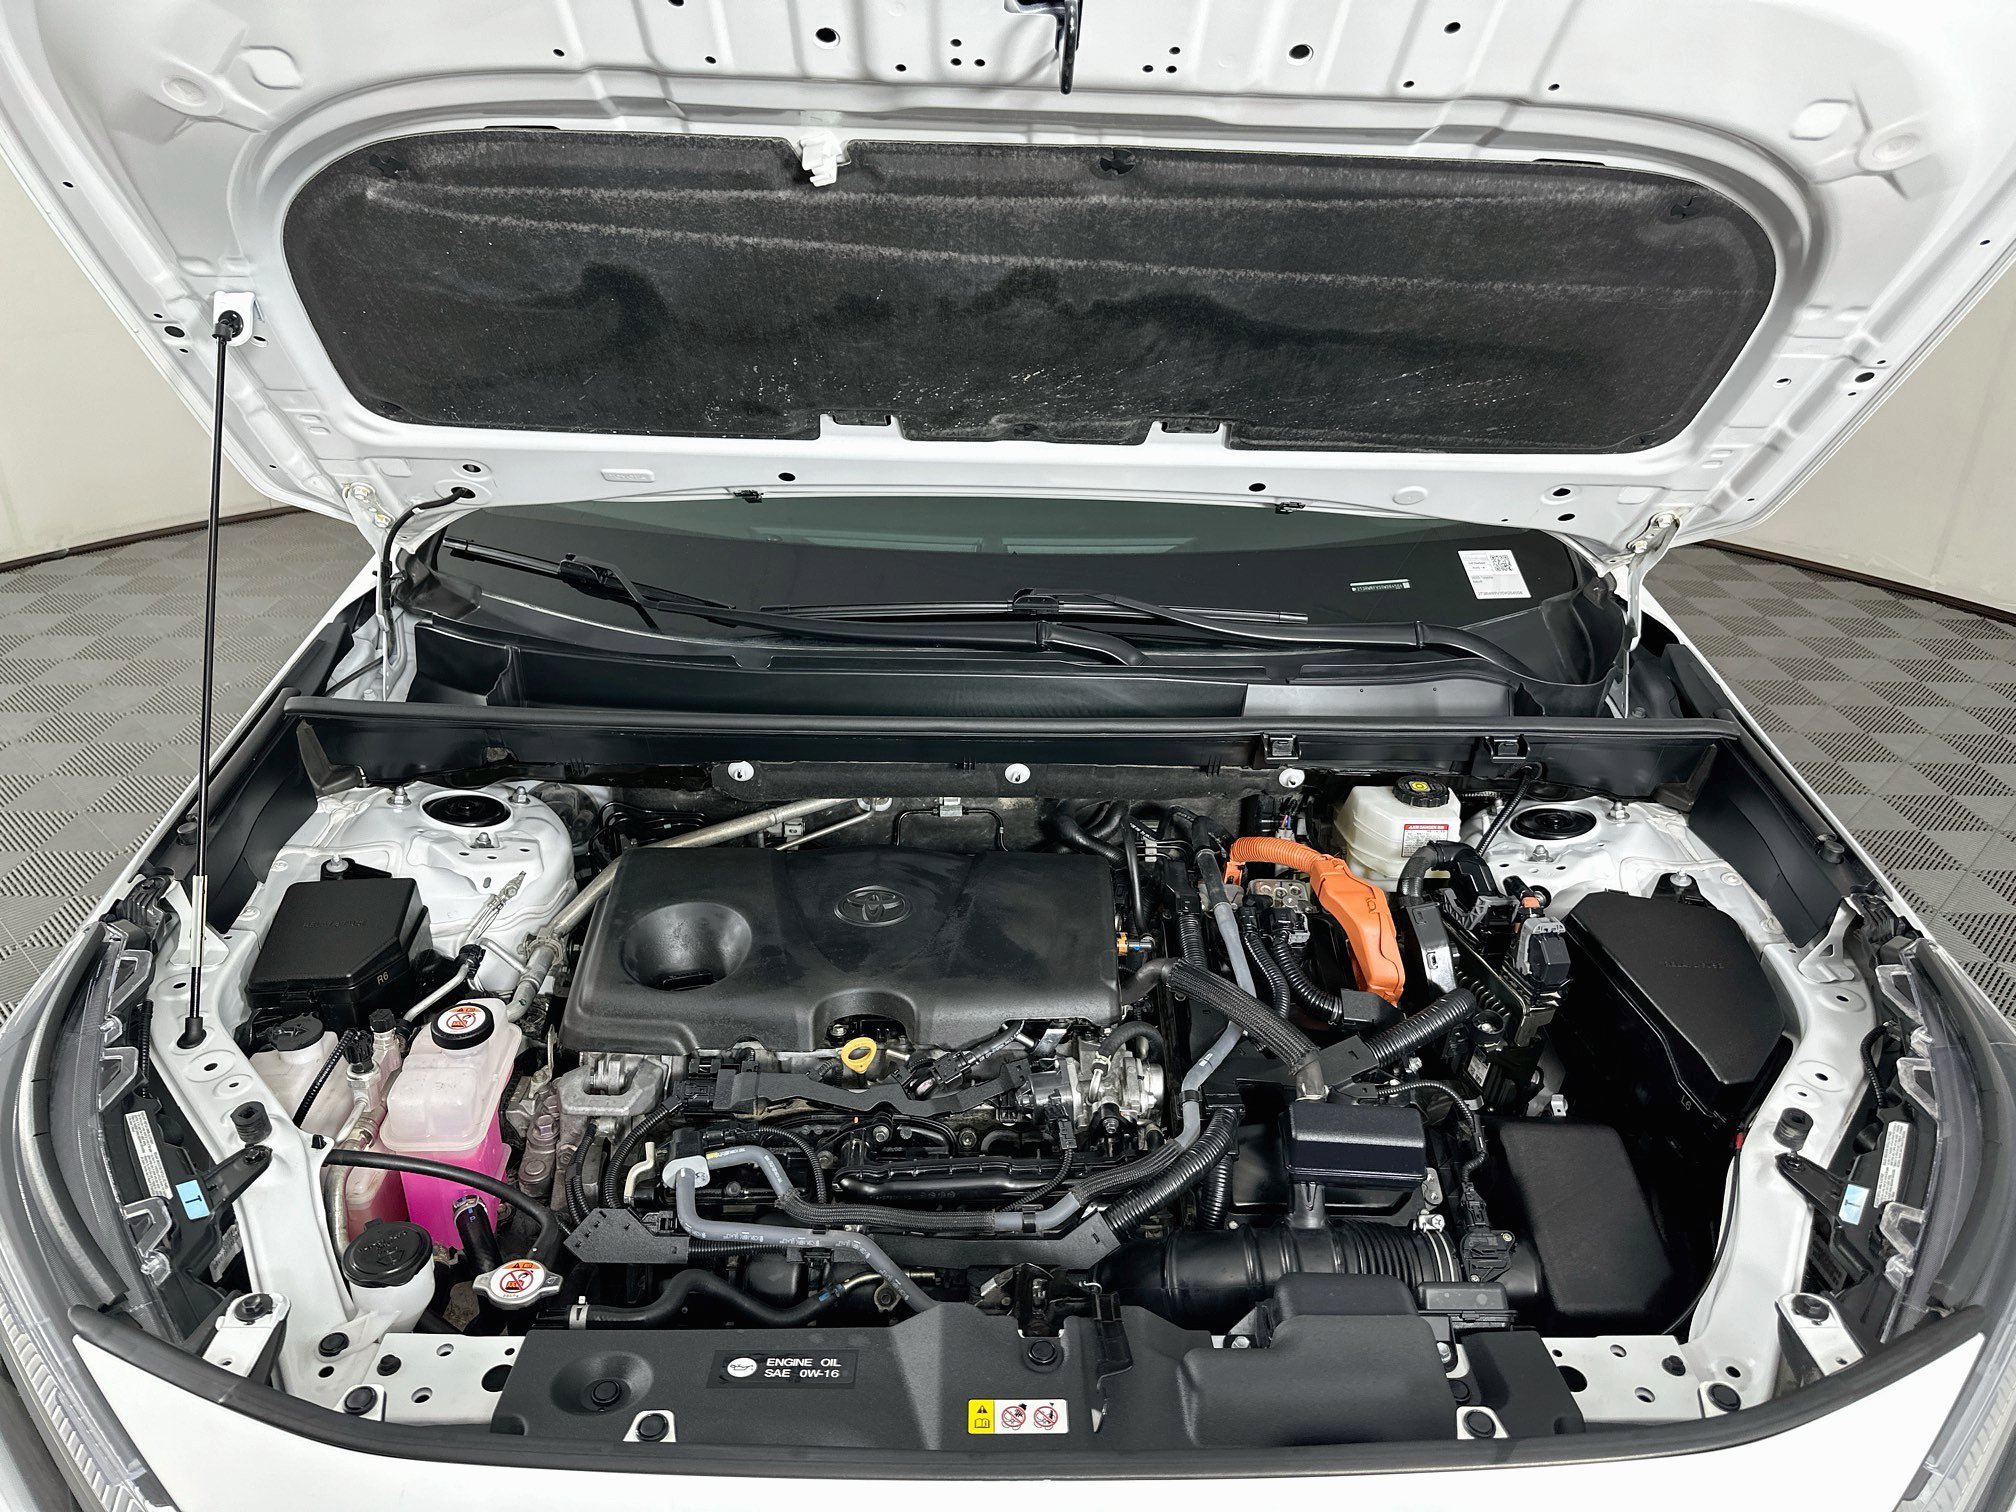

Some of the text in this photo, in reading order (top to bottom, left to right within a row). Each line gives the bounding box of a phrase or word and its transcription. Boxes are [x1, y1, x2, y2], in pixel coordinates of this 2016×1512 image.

[376, 973, 389, 985] R6
[1680, 1095, 1692, 1111] L6
[766, 1357, 842, 1367] ENGINE OIL
[764, 1368, 840, 1378] SAE 0W-16
